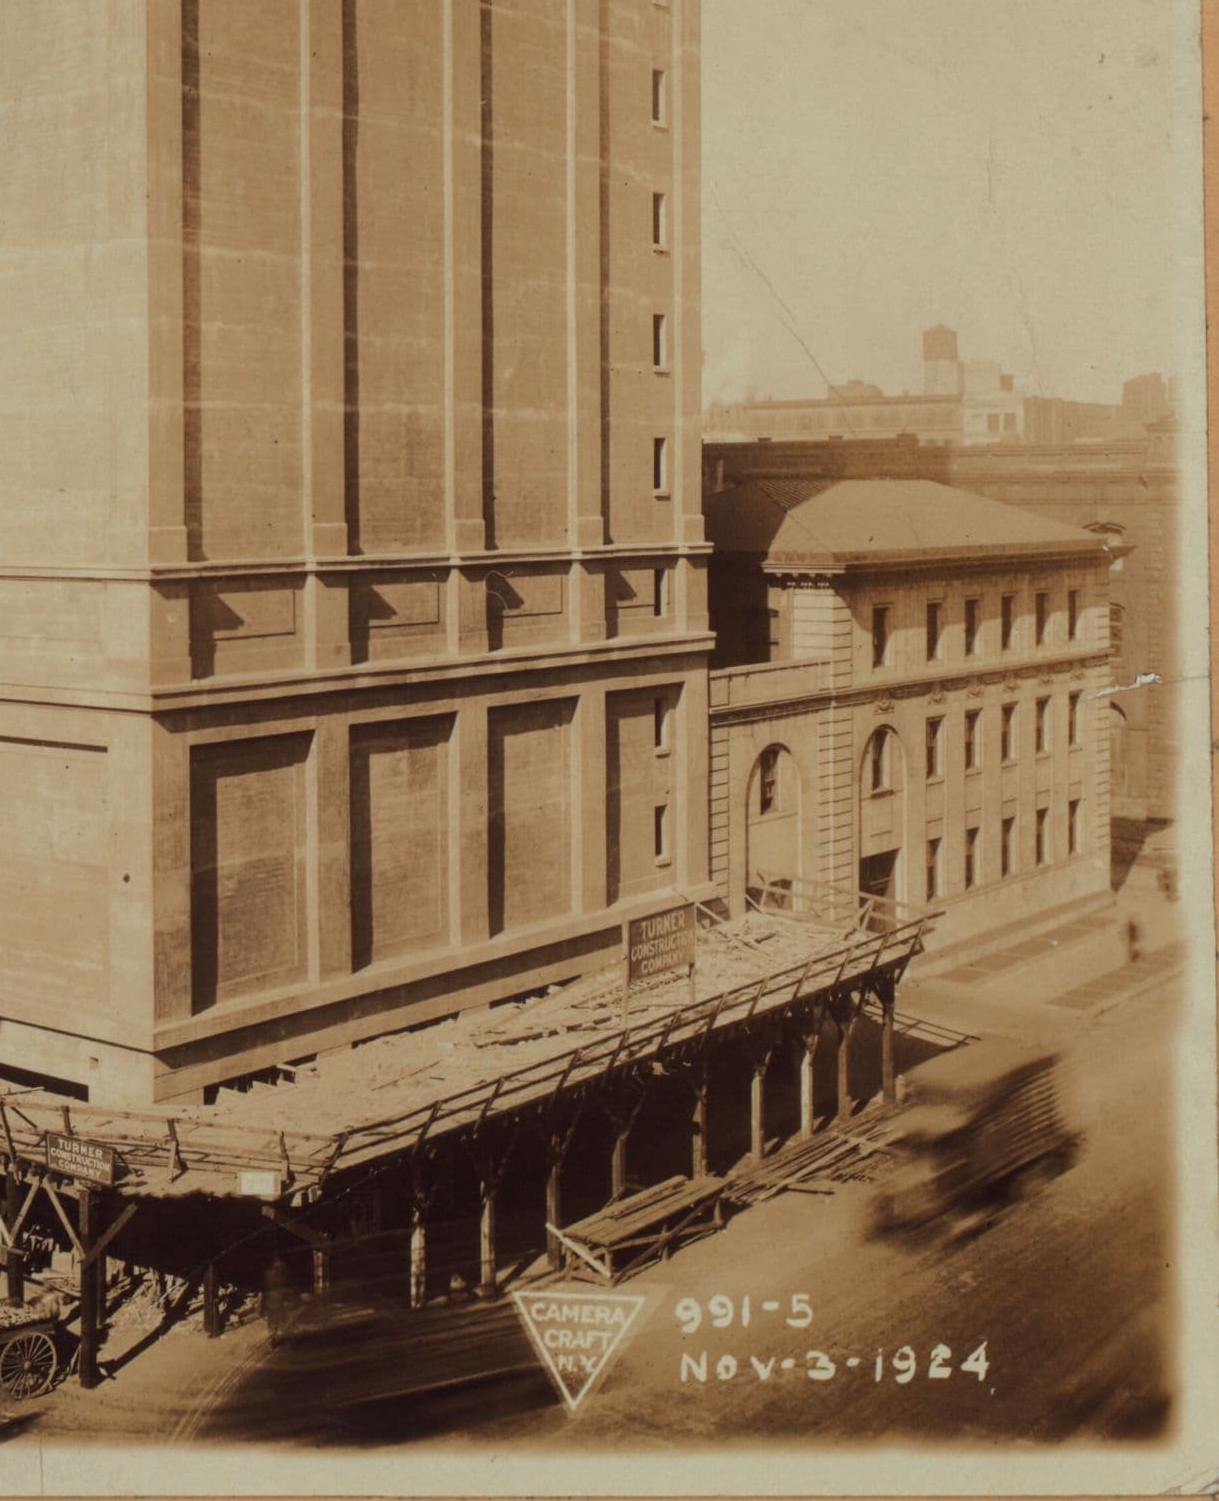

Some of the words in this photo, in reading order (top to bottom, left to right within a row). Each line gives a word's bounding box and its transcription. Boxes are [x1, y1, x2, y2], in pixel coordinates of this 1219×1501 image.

[640, 910, 685, 939] TURNER
[641, 949, 684, 974] COMPANY
[50, 1147, 110, 1172] CONSTRUCTION
[58, 1138, 103, 1160] TURNER
[58, 1159, 102, 1179] COMPANY
